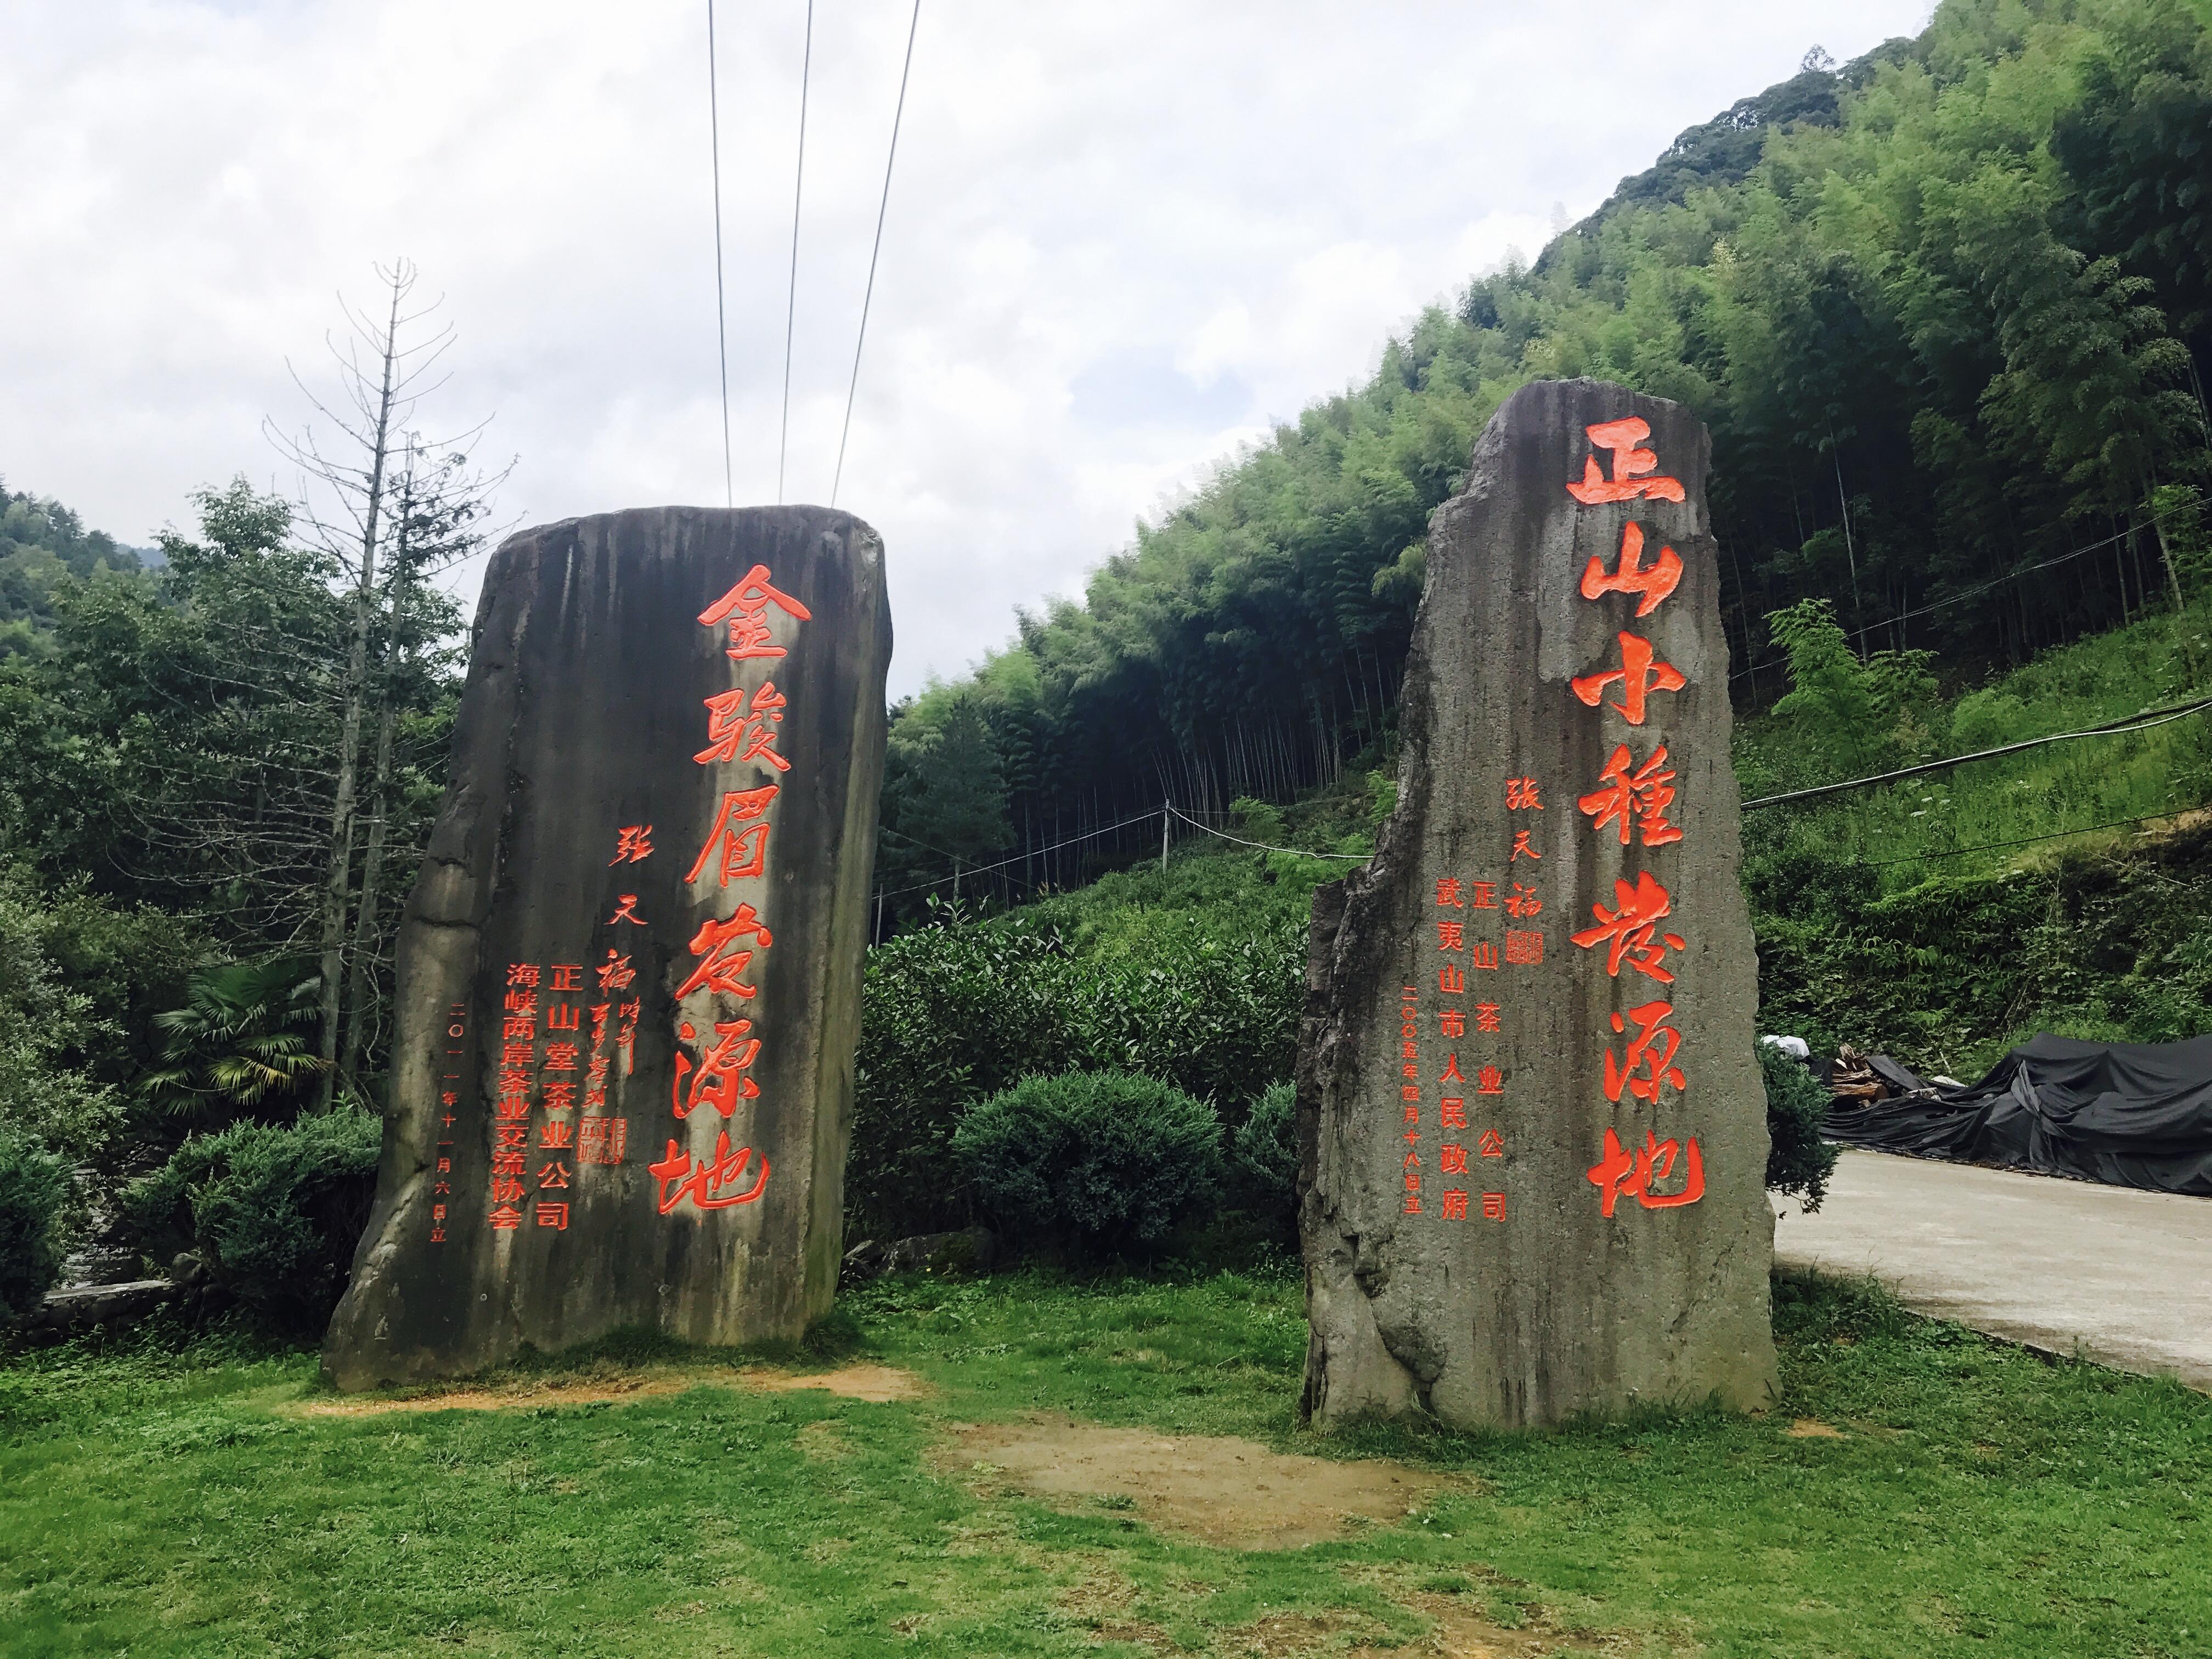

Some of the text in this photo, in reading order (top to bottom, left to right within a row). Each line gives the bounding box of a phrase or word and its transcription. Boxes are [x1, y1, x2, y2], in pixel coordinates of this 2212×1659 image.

[488, 962, 541, 1231] 海峡两岸茶业交流协会
[535, 963, 584, 1231] 正山堂茶业公司
[1436, 877, 1469, 1221] 武夷山市人民政府
[1471, 881, 1506, 1223] 正山茶业公司
